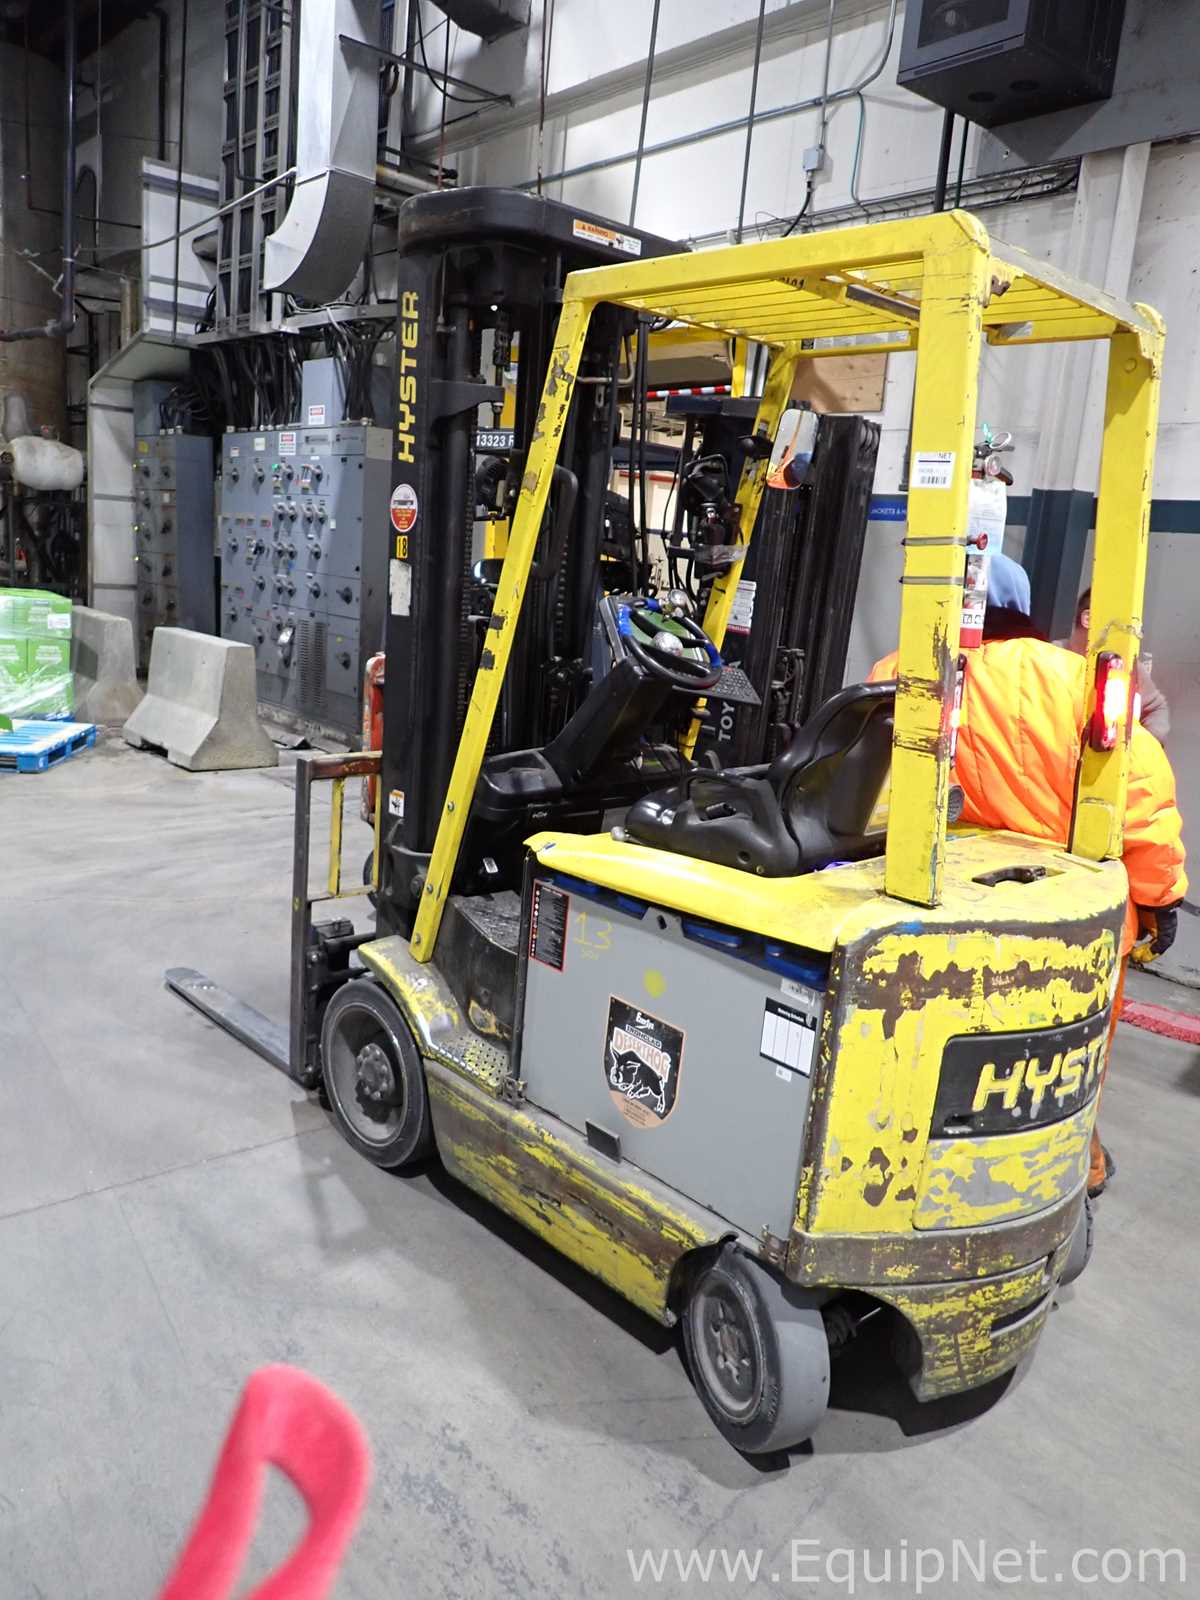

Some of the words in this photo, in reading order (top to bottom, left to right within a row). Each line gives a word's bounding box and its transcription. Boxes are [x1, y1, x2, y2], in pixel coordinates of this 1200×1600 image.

[398, 290, 419, 464] HYSTER
[398, 537, 407, 557] 18
[574, 911, 615, 950] 13
